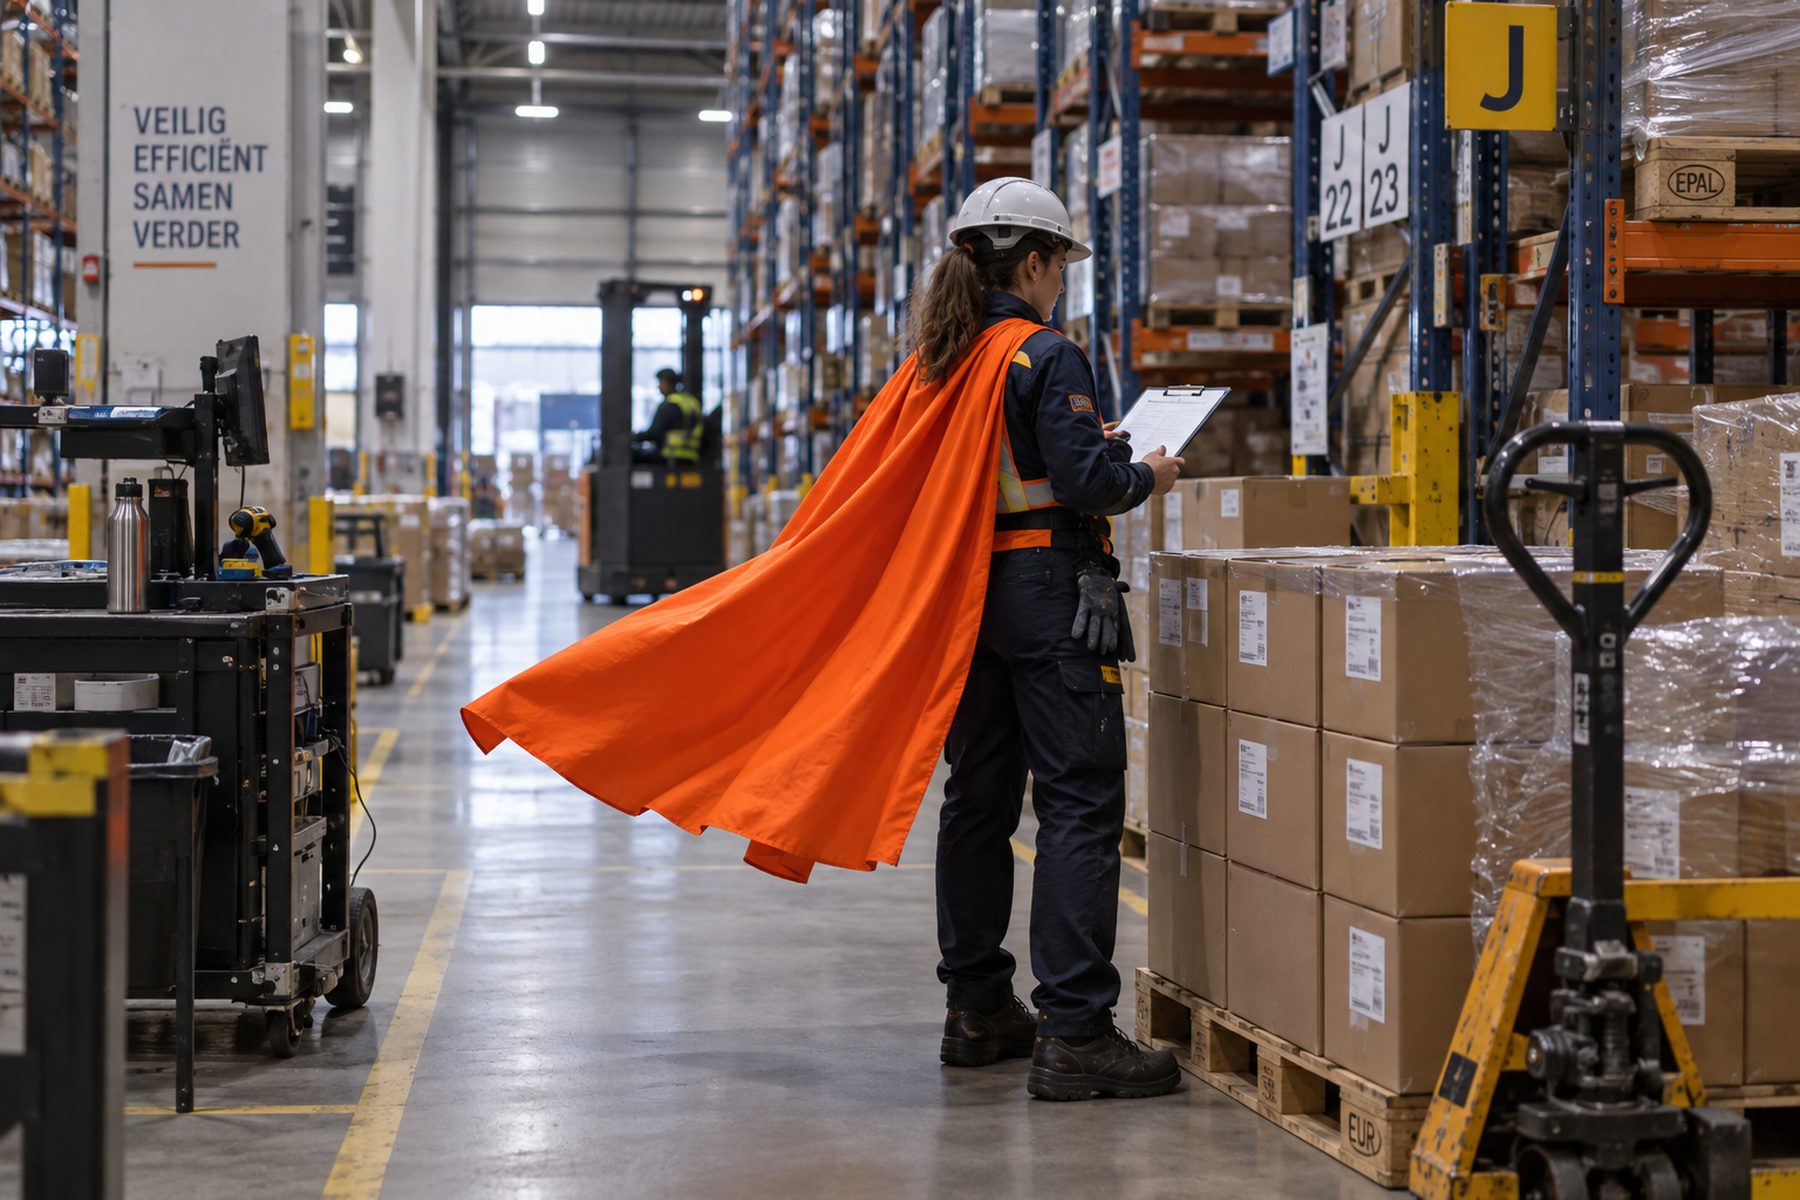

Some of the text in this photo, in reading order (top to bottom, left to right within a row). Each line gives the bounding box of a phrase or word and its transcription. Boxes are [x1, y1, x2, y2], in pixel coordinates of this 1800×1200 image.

[1480, 24, 1525, 113] J
[133, 105, 227, 136] VEILIG
[1378, 105, 1391, 154] J
[133, 137, 269, 174] EFFICIËNT
[1333, 125, 1345, 171] J
[133, 181, 234, 212] SAMEN
[1369, 162, 1399, 219] 23
[1675, 172, 1719, 194] EPAL
[1325, 179, 1353, 233] 22
[133, 219, 241, 250] VERDER
[1348, 1111, 1376, 1154] EUR
